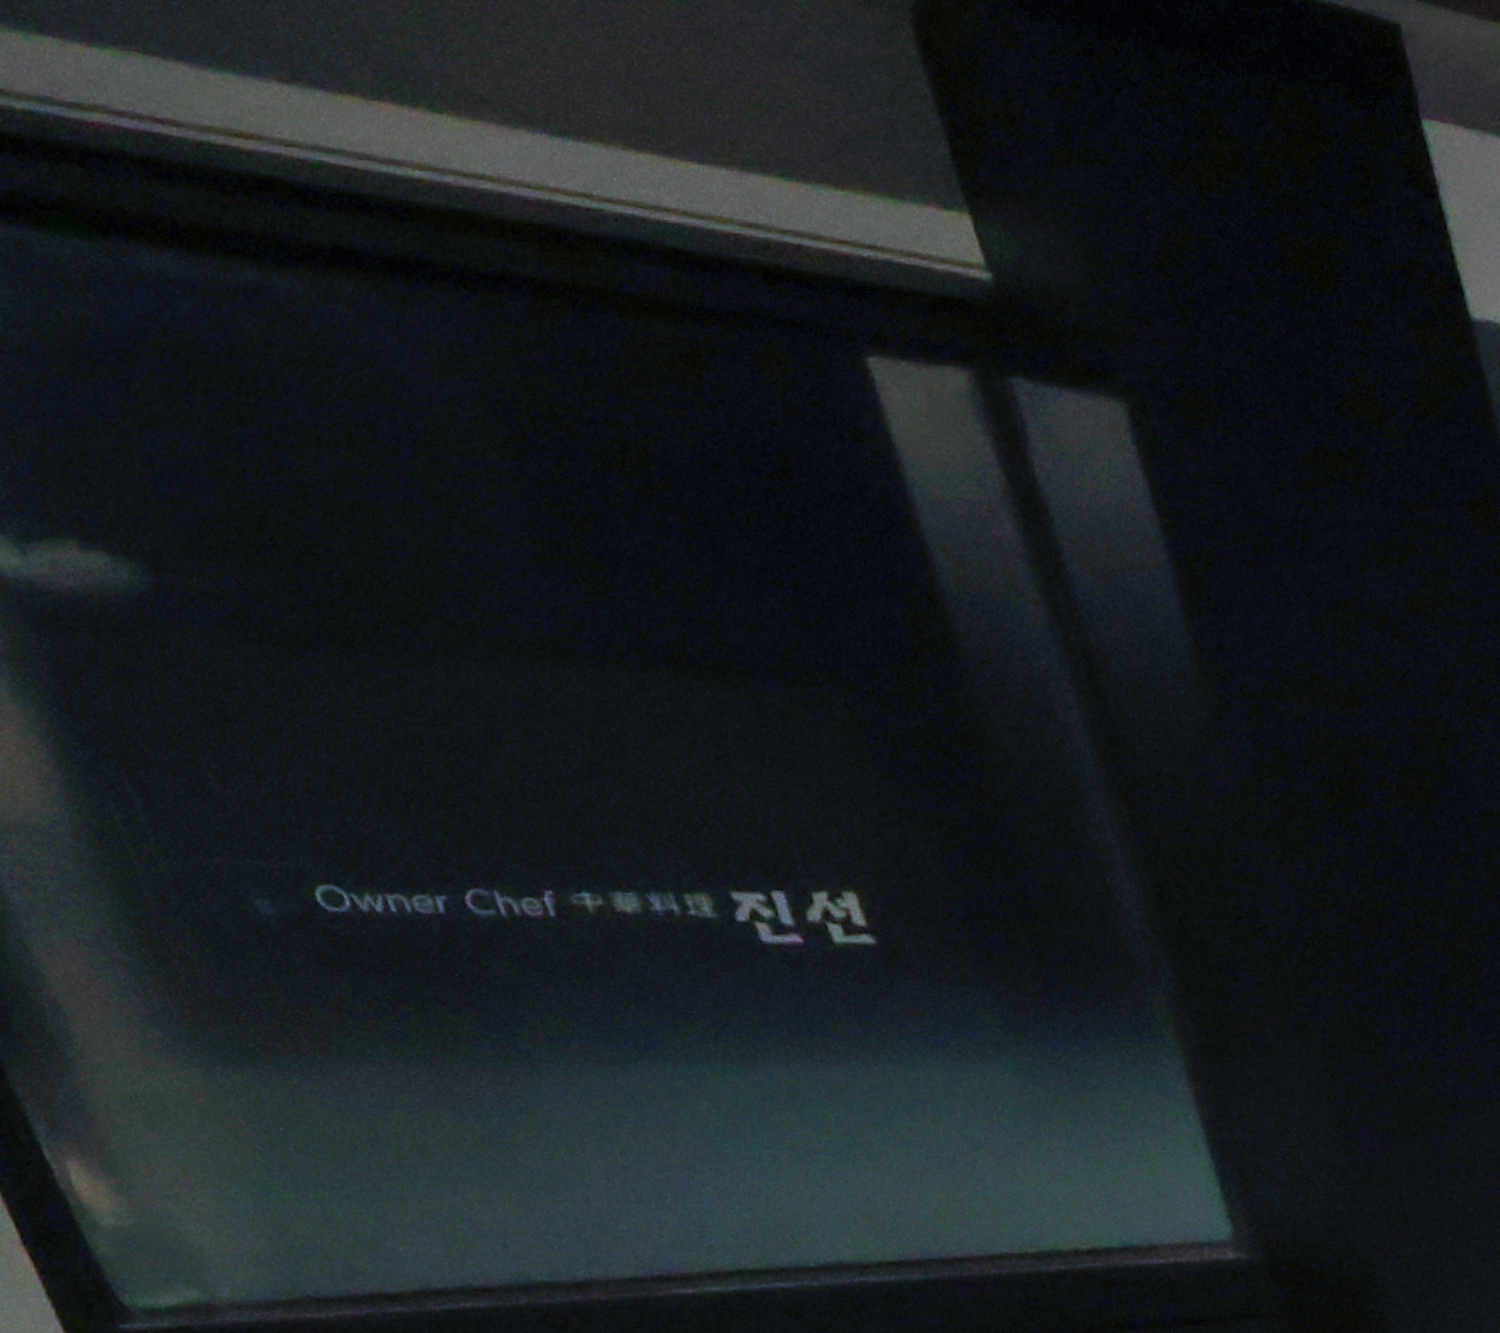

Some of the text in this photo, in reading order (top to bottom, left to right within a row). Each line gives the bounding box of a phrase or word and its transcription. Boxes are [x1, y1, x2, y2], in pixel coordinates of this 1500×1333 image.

[315, 884, 447, 916] Owner
[464, 887, 557, 918] Chef
[729, 889, 878, 946] 진선
